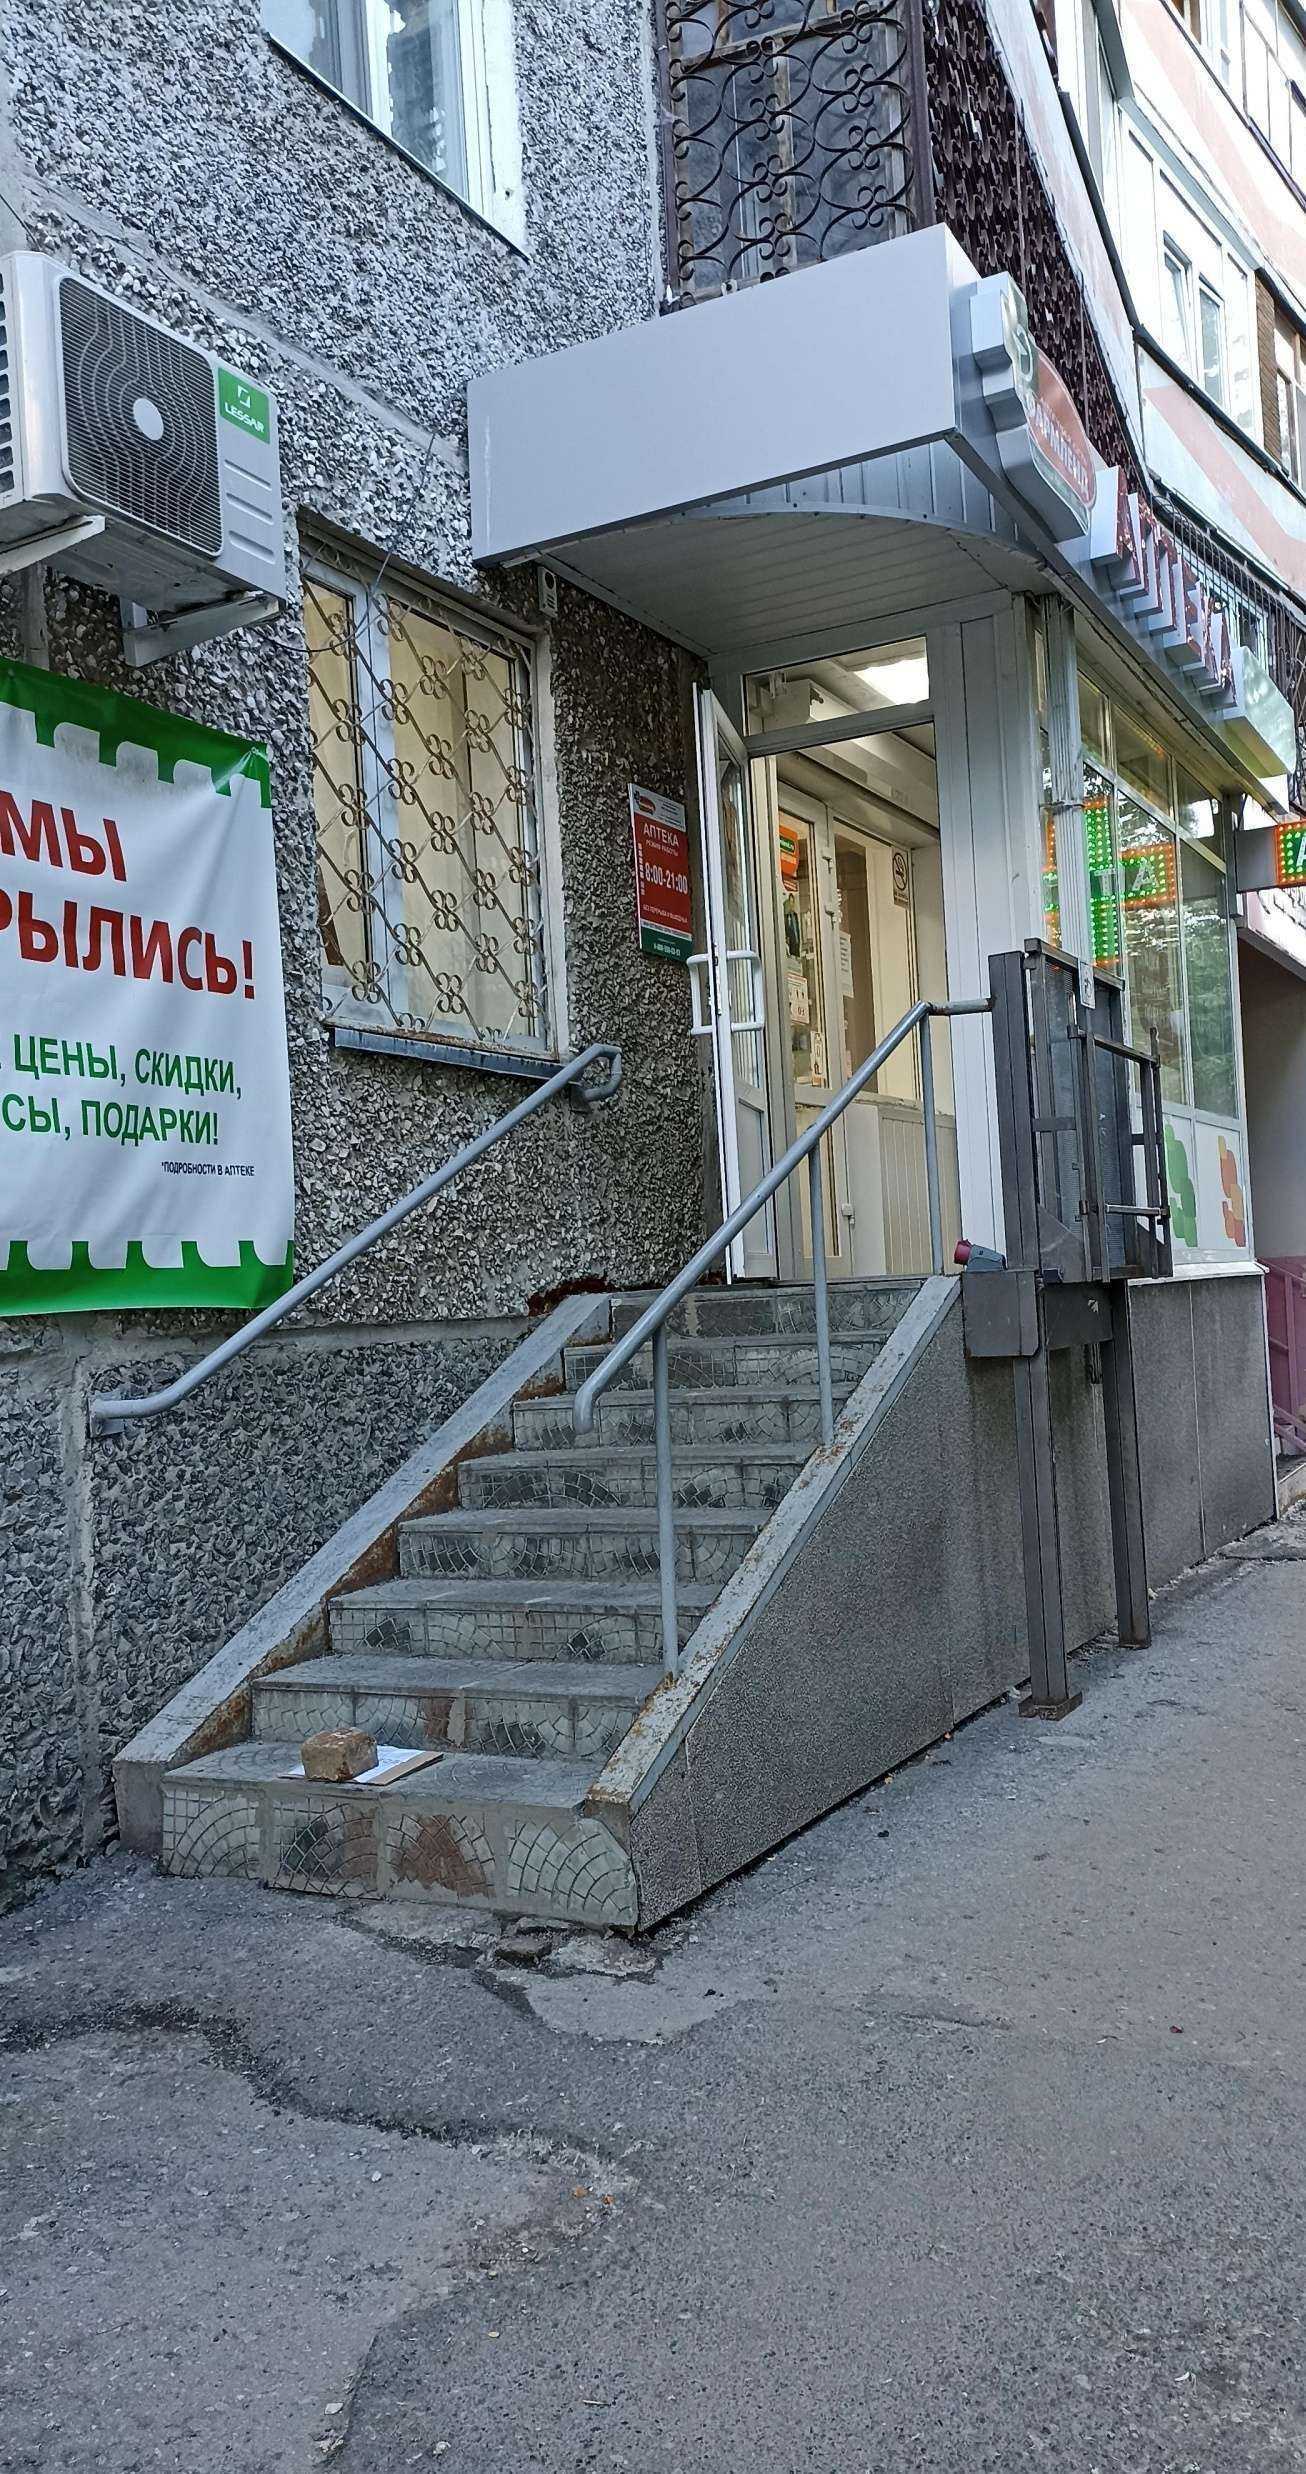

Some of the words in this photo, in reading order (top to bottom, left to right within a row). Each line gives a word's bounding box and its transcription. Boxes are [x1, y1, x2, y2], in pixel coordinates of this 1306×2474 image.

[225, 402, 264, 433] LESSAR
[0, 790, 127, 882] МЫ
[643, 823, 679, 847] АПТЕКА
[645, 862, 688, 894] 8:00-21:00
[14, 1034, 125, 1087] ЦЕНЫ,
[135, 1049, 241, 1099] СКИДКИ,
[81, 1099, 218, 1147] ПОДАРКИ!
[217, 1164, 223, 1175] В
[225, 1165, 255, 1177] АПТЕКЕ
